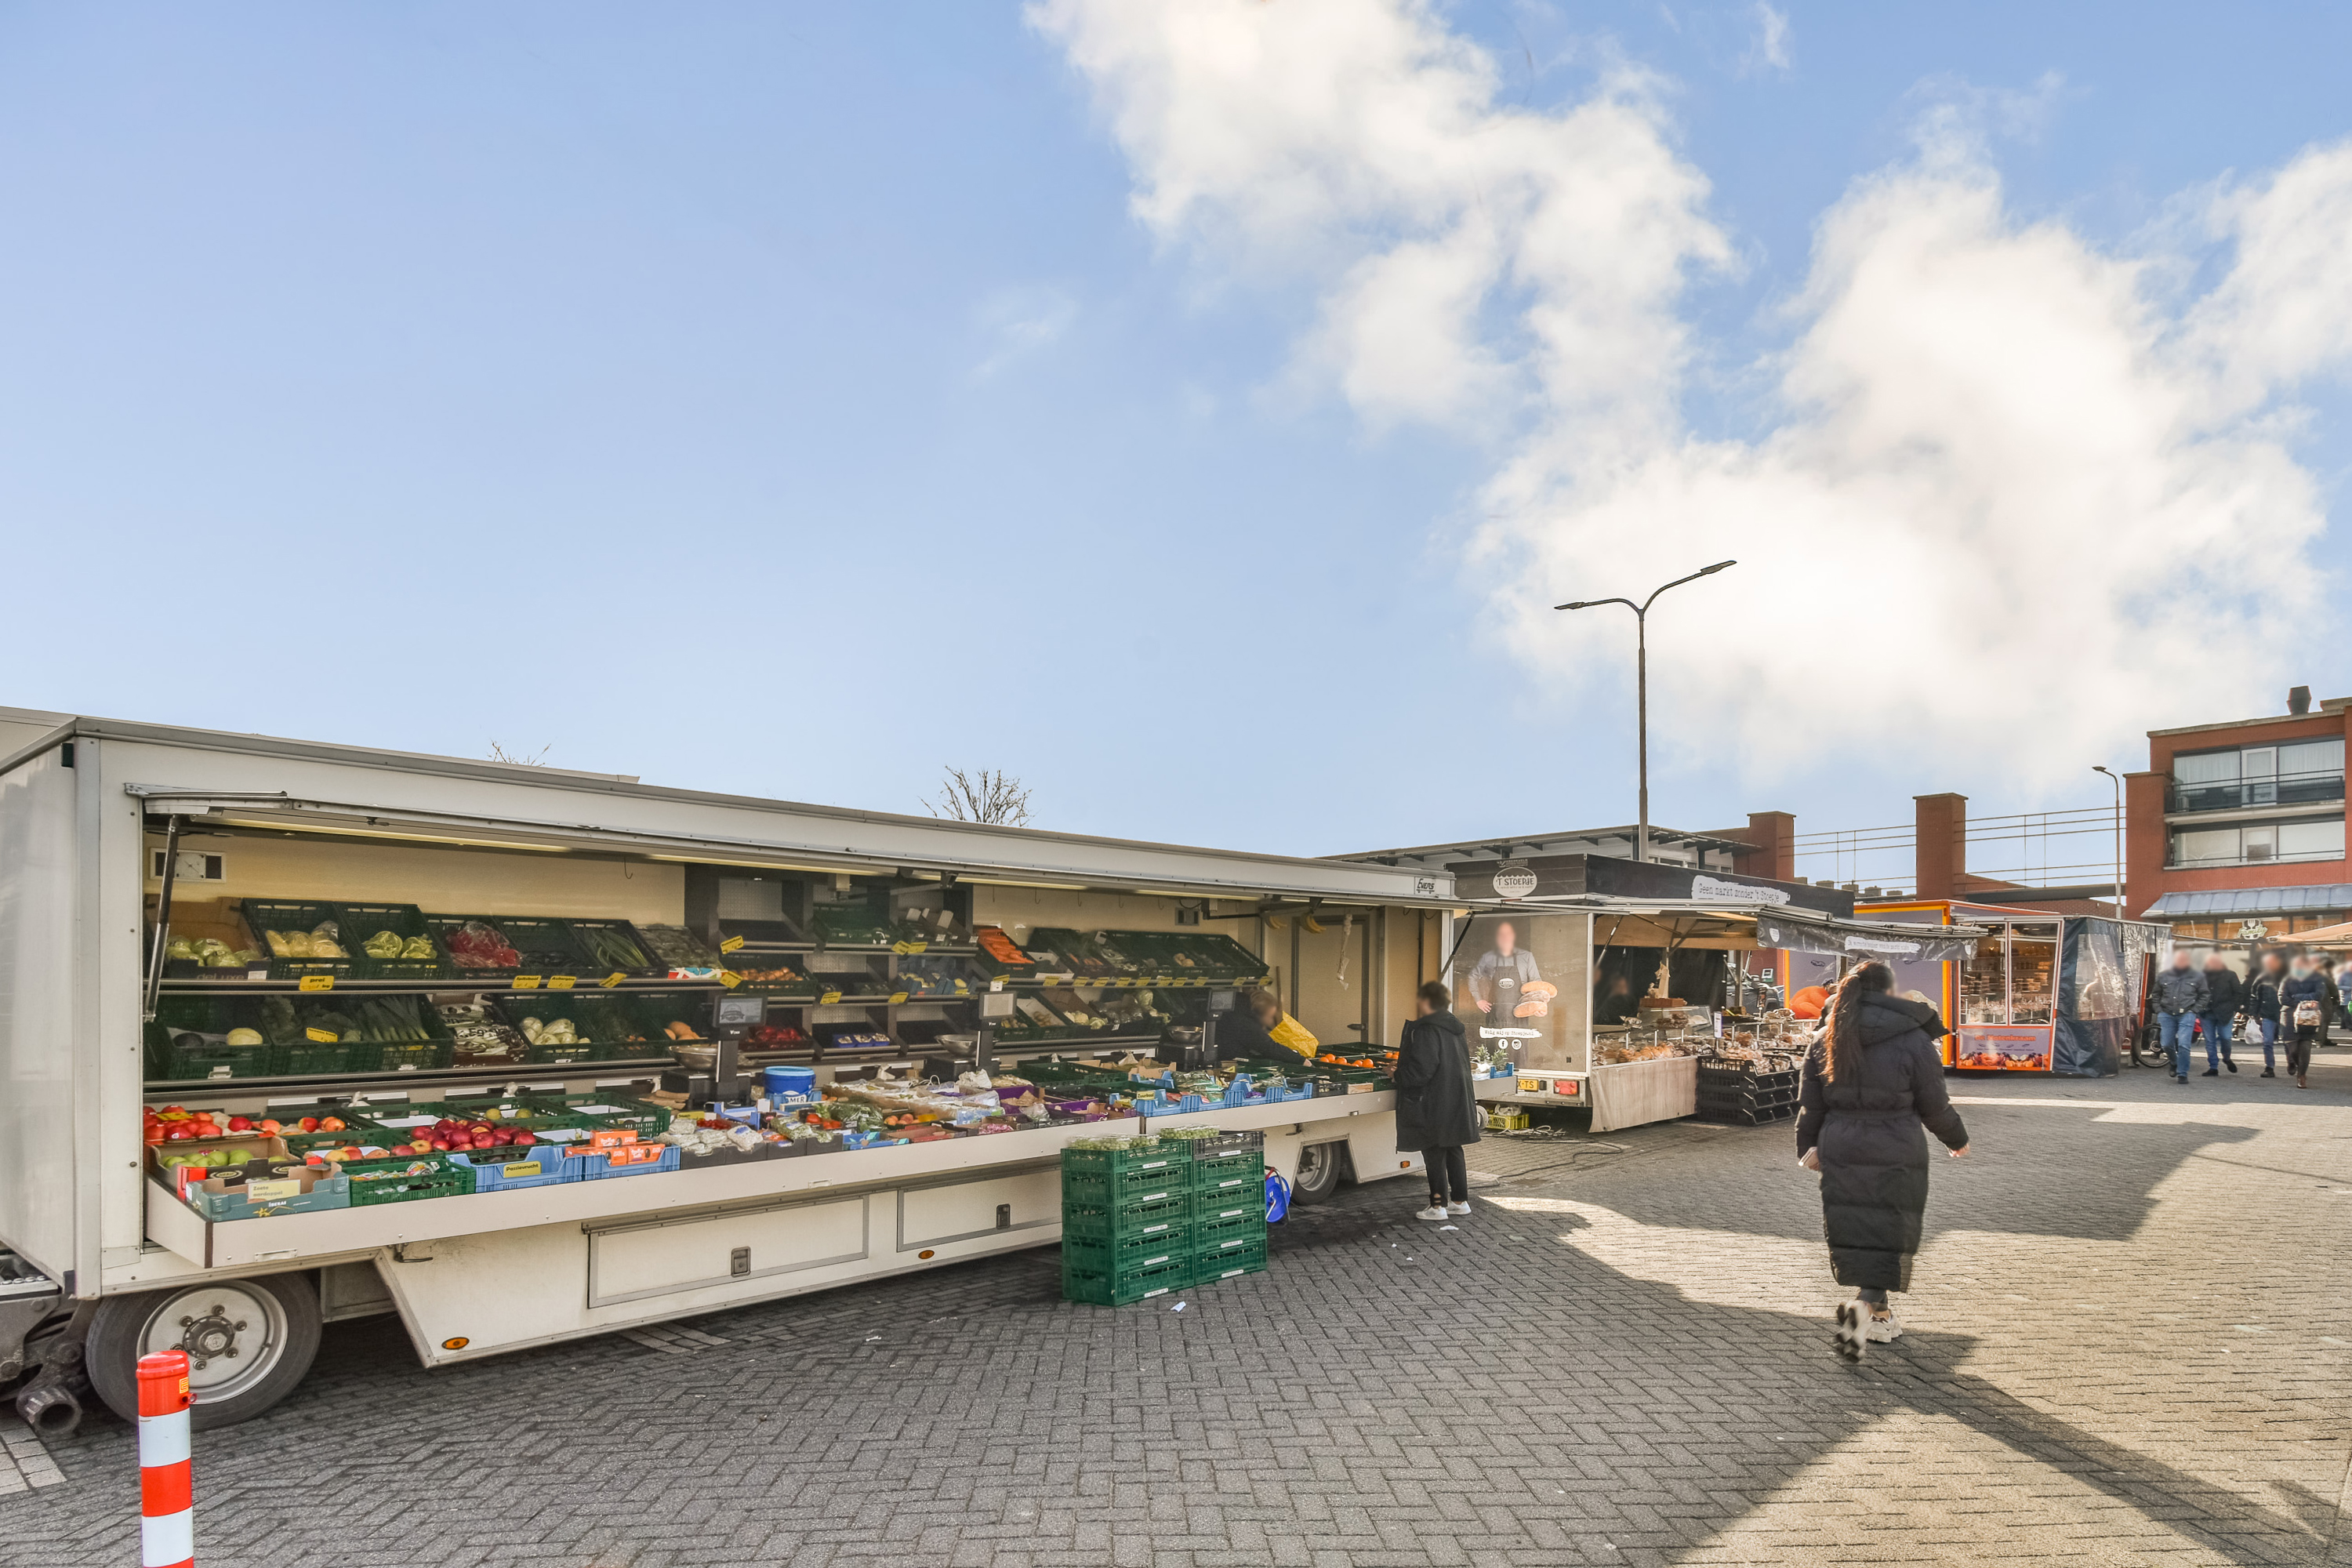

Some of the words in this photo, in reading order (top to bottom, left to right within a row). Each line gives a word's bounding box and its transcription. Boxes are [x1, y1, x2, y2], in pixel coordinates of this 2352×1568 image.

[1504, 877, 1534, 886] STOEPJE
[1698, 883, 1713, 895] Geen
[1715, 886, 1733, 897] markt
[1734, 888, 1753, 899] zonder
[1760, 891, 1780, 903] Stoepje
[2237, 924, 2268, 938] Family
[506, 1163, 539, 1171] Passievrucht
